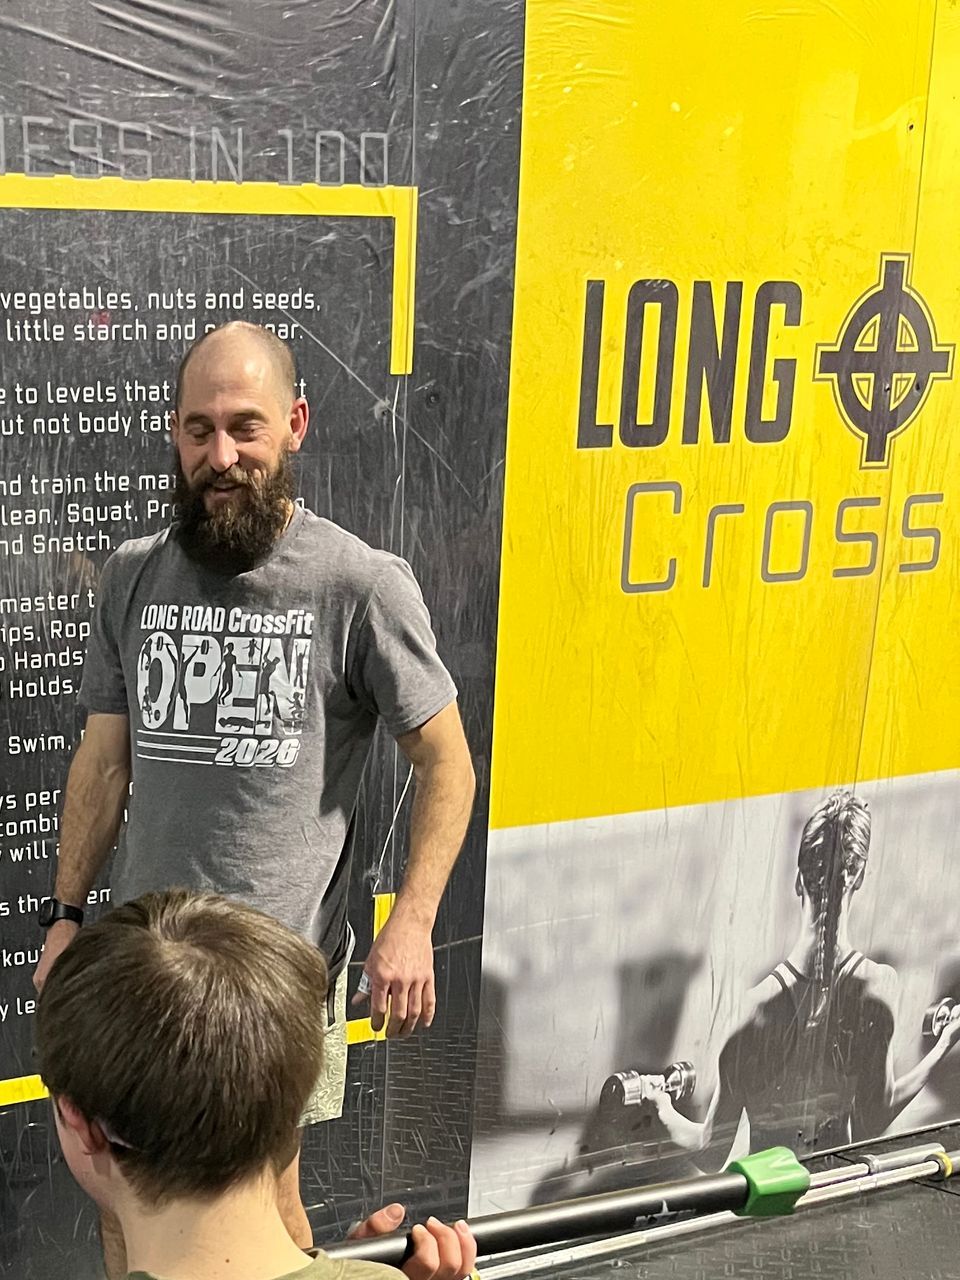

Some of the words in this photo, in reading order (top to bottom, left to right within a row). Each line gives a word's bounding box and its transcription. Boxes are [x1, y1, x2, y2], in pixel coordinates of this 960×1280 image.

[190, 125, 243, 183] IN
[278, 127, 389, 187] 100
[0, 287, 138, 314] vegetables,
[148, 287, 196, 310] nuts
[205, 287, 243, 309] and
[253, 288, 320, 310] seeds,
[7, 319, 64, 341] little
[74, 319, 146, 341] starch
[157, 318, 195, 340] and
[577, 279, 802, 449] LONG
[15, 383, 37, 404] to
[47, 381, 116, 403] levels
[125, 381, 170, 401] that
[34, 413, 70, 434] not
[79, 411, 131, 436] body
[31, 475, 86, 495] train
[95, 471, 129, 492] the
[68, 502, 137, 526] Squat,
[33, 533, 116, 553] Snatch.
[621, 481, 945, 594] Cross
[0, 592, 79, 613] master
[51, 620, 90, 641] Rop
[140, 604, 179, 630] LONG
[181, 605, 226, 632] ROAD
[228, 606, 315, 635] CrossFit
[15, 648, 87, 670] Hands
[10, 676, 79, 698] Holds.
[137, 631, 312, 736] OPEN
[9, 733, 71, 754] Swim,
[215, 737, 301, 768] 2026
[26, 790, 60, 811] per
[10, 841, 48, 861] will
